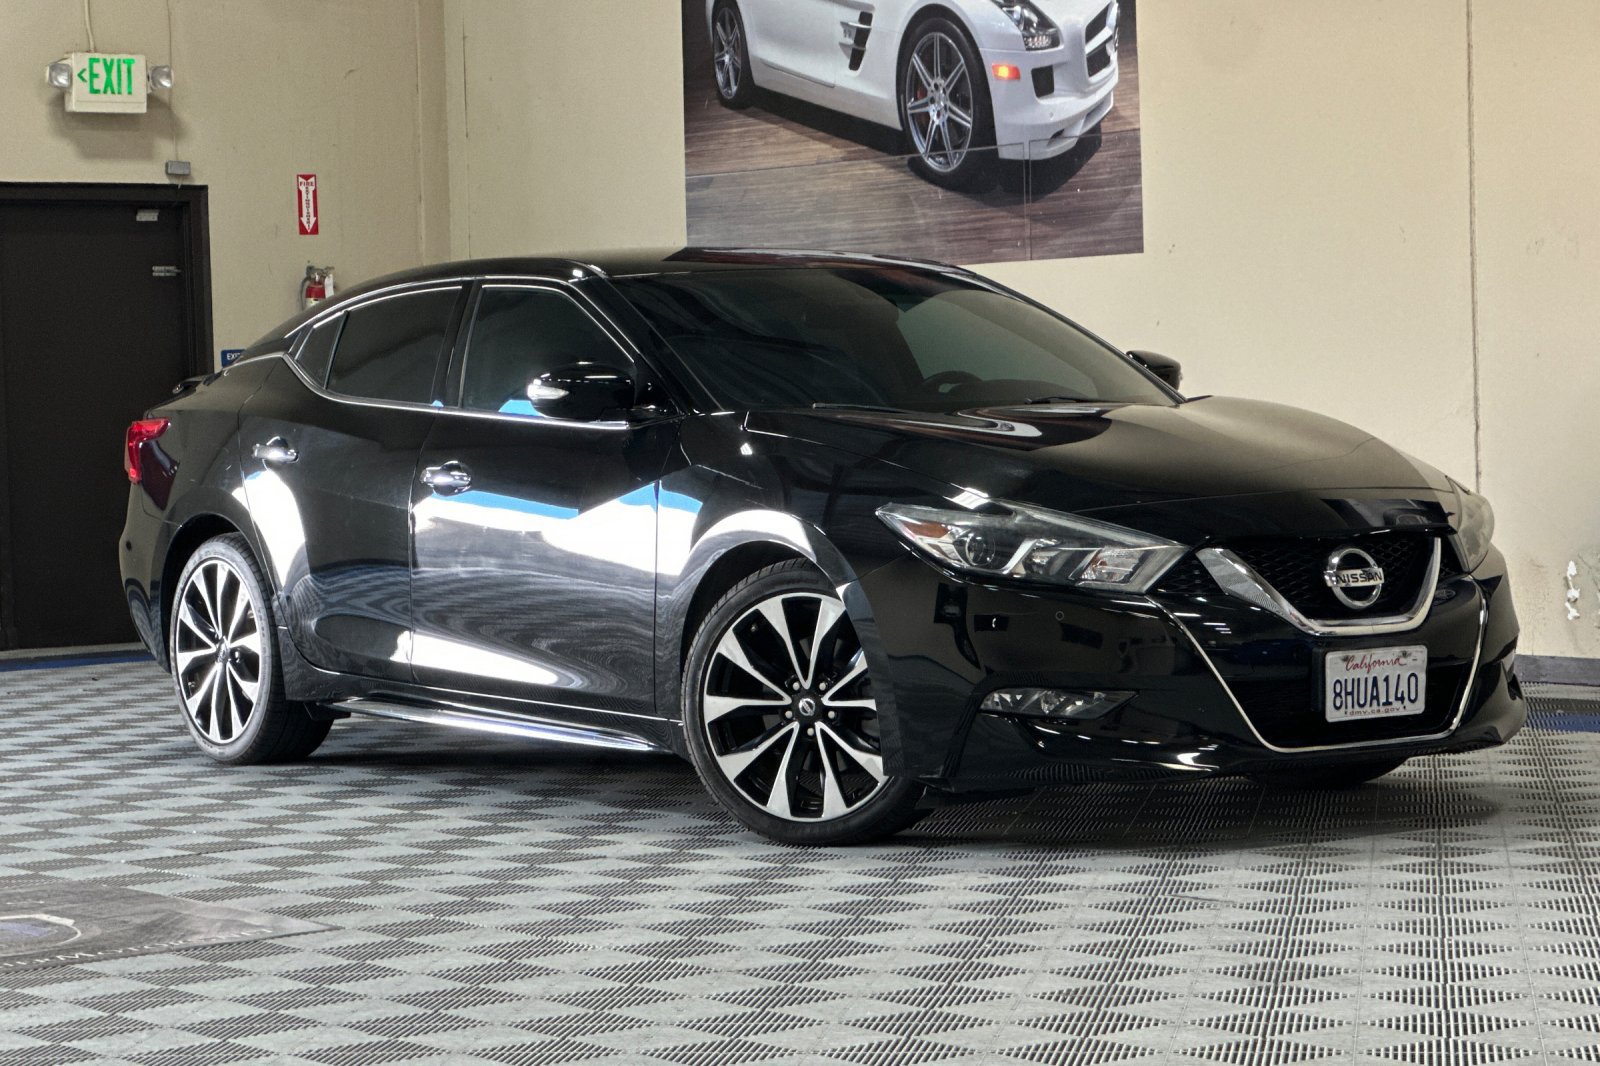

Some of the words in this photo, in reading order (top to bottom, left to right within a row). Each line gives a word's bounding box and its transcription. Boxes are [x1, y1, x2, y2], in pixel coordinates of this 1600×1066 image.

[88, 57, 135, 95] EXIT
[1336, 571, 1383, 584] NISSAN
[1345, 655, 1406, 673] California
[1333, 673, 1418, 710] 8HUA140
[1349, 707, 1400, 716] dmv.ca.gov
